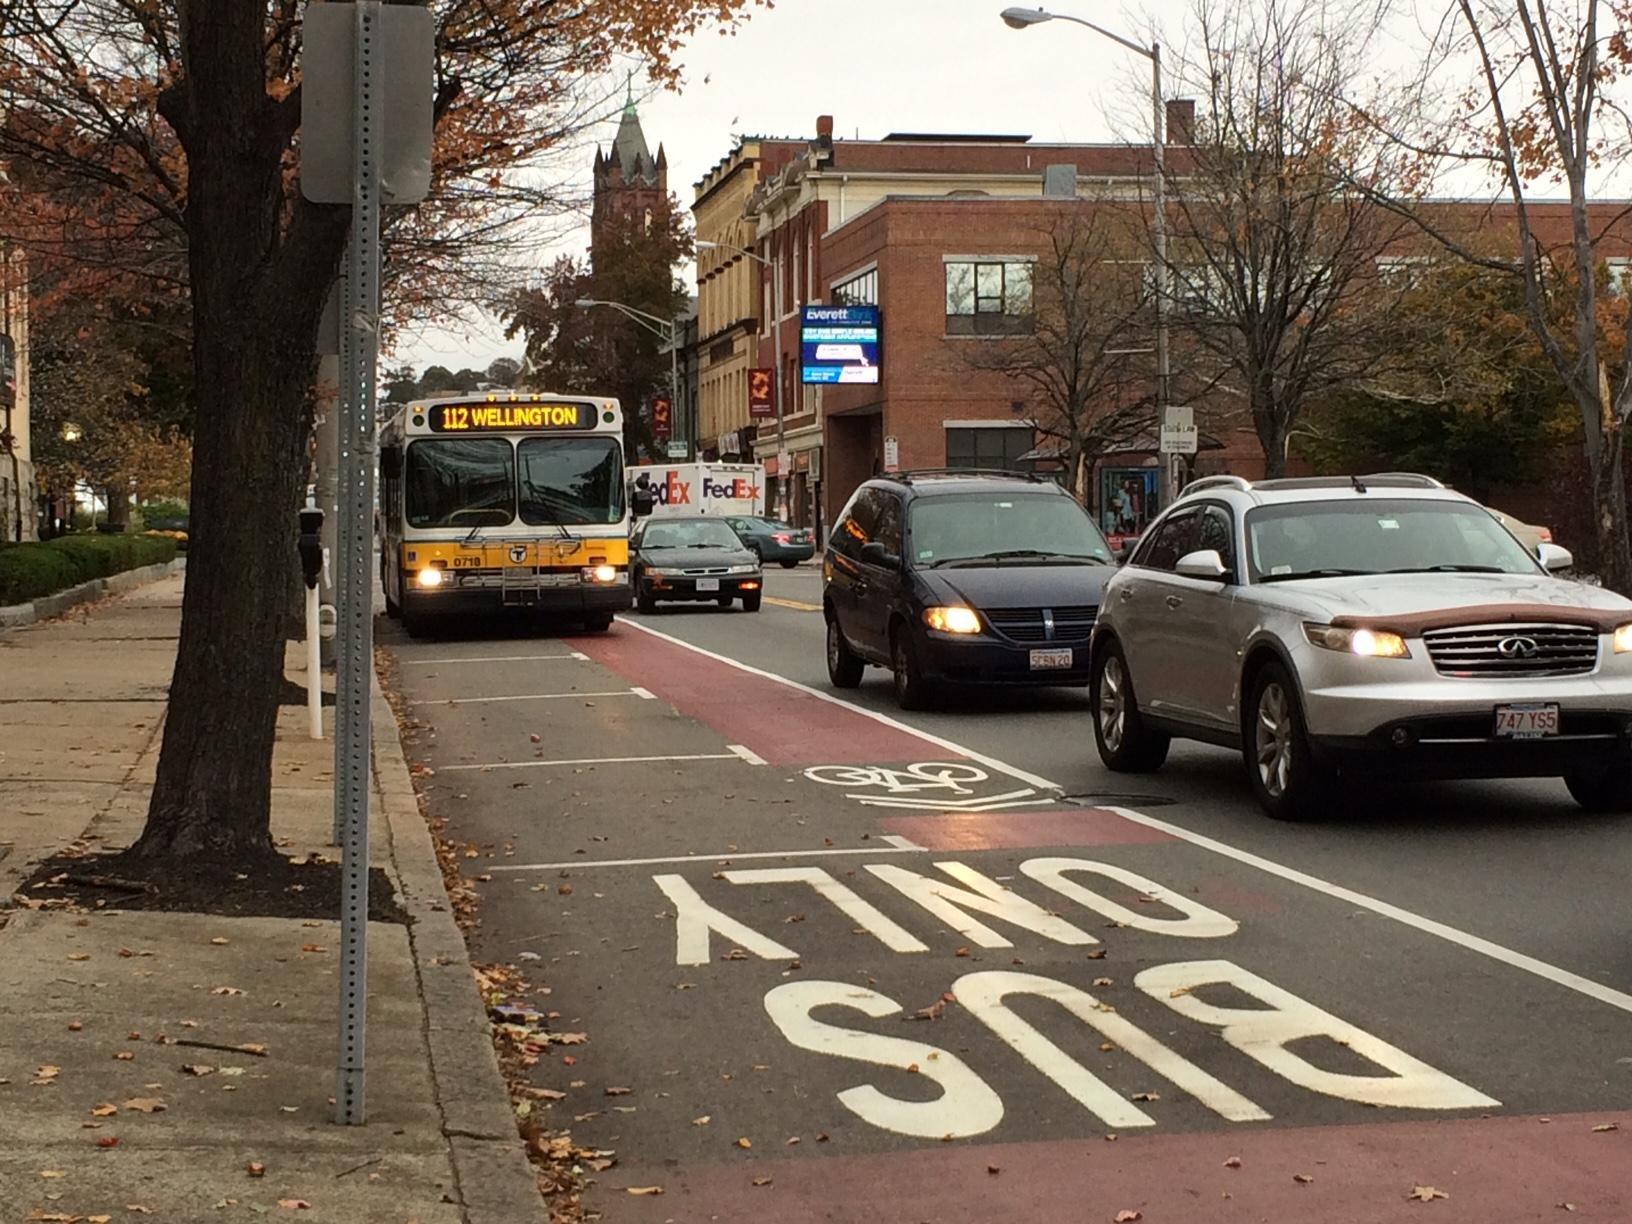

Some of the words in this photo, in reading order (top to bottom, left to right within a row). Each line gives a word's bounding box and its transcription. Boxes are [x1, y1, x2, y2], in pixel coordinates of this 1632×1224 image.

[443, 408, 469, 429] 112
[471, 407, 577, 426] WELLINGTON
[703, 478, 760, 499] FedEx
[1497, 712, 1524, 729] 747
[1528, 711, 1556, 729] YS5
[652, 857, 1240, 966] ONLY
[764, 961, 1502, 1140] BUS
